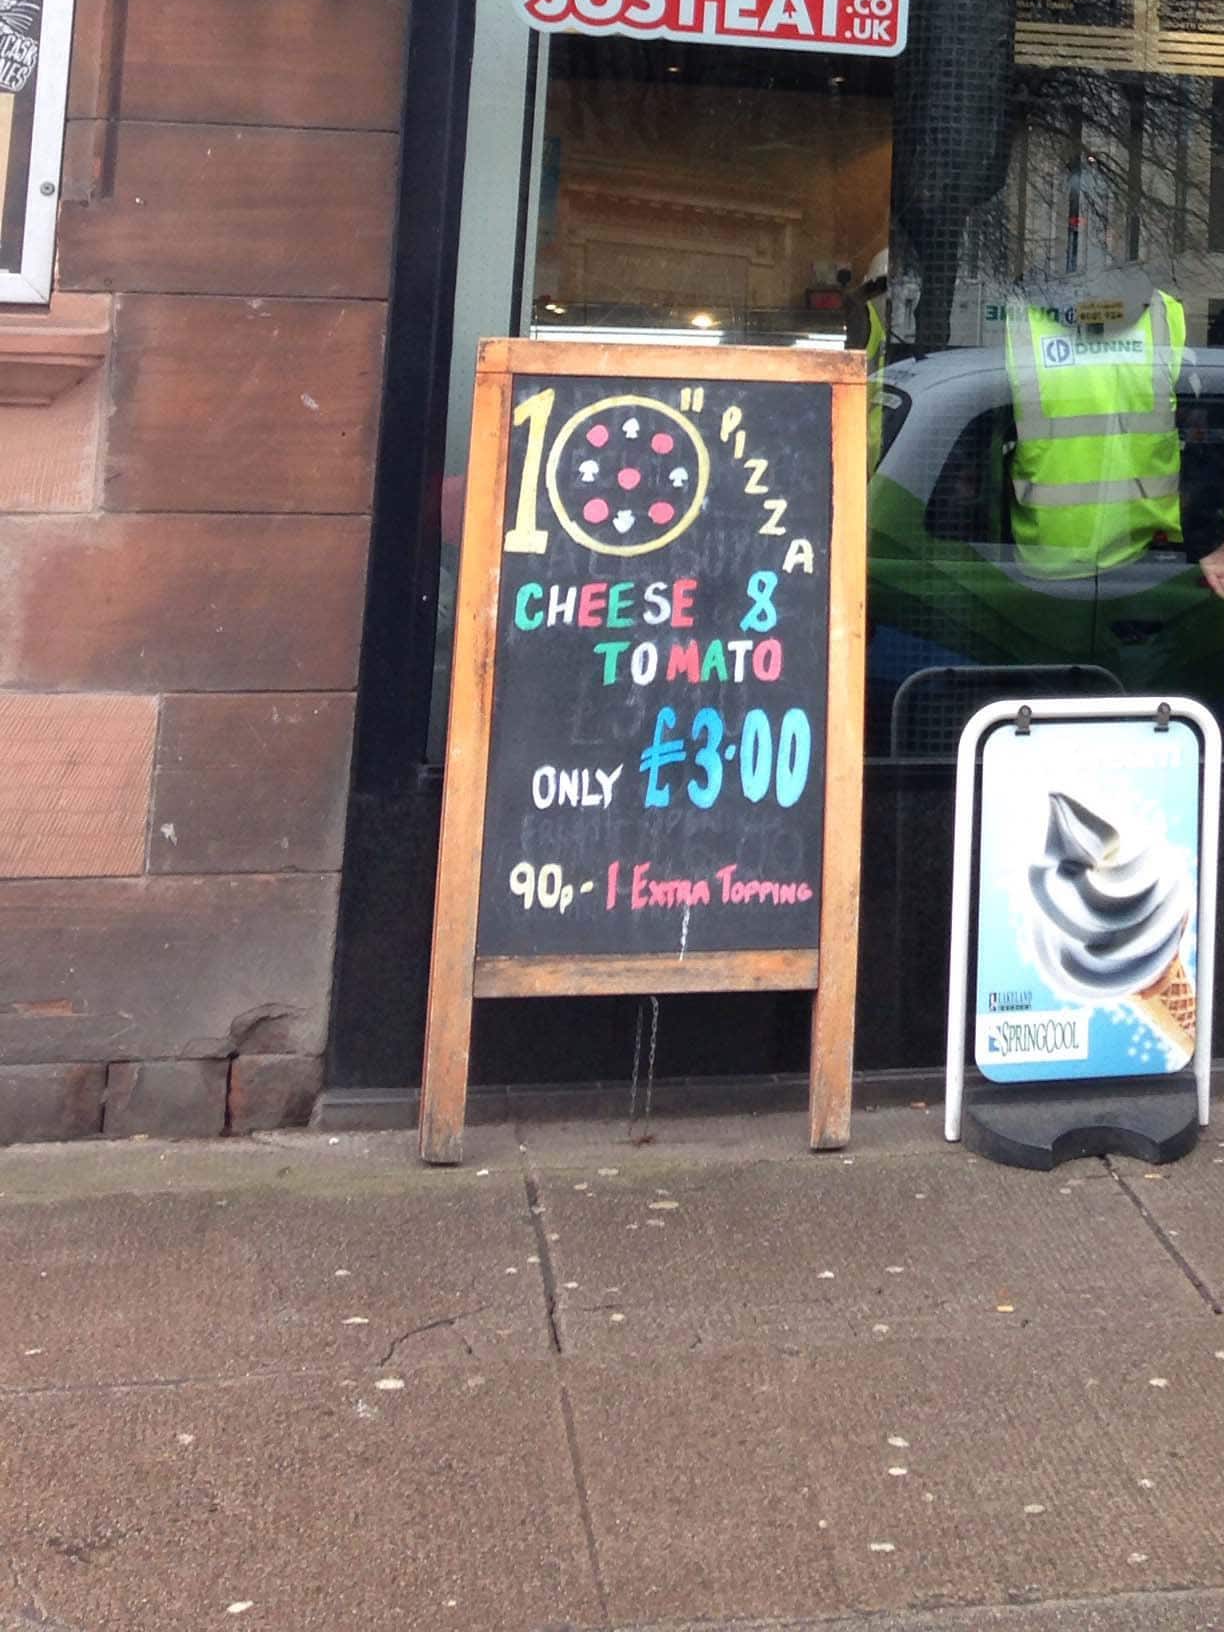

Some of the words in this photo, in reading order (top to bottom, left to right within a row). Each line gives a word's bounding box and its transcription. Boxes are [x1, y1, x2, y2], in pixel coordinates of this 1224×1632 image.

[1, 35, 38, 65] CASK
[0, 58, 28, 91] LES
[1075, 339, 1144, 355] DUNNE
[514, 578, 698, 631] CHEESE
[593, 637, 783, 685] TOMATO
[531, 763, 624, 809] ONLY
[639, 706, 812, 809] £3.00
